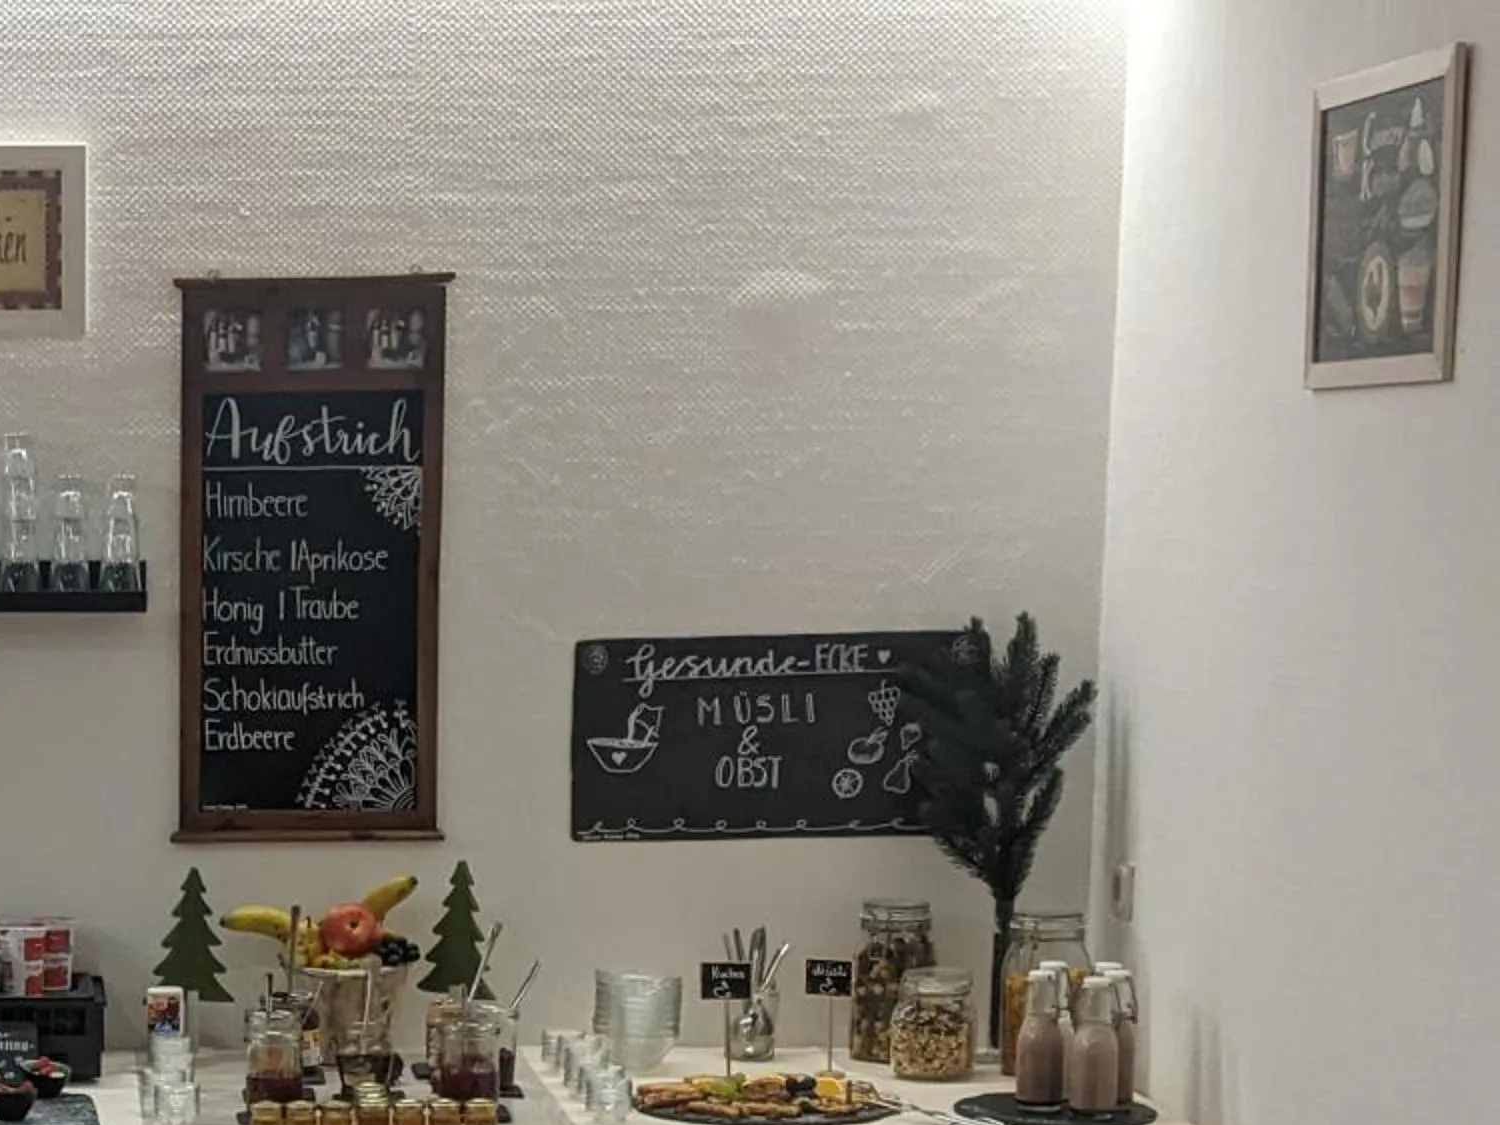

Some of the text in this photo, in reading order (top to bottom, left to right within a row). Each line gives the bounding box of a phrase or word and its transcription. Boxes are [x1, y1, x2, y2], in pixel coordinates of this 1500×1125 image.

[205, 397, 420, 465] Aufstrich
[205, 480, 309, 519] Himbeere
[203, 535, 281, 572] Kirsche
[297, 537, 389, 584] Aprikose
[201, 586, 264, 635] Honig
[290, 584, 360, 620] Traube
[203, 631, 338, 666] Erdnussbutter
[203, 676, 365, 716] Schokiaufstrich
[697, 691, 816, 726] MÜSLI
[204, 719, 296, 751] Erdbeere
[737, 725, 761, 756] &
[715, 755, 783, 789] OBST
